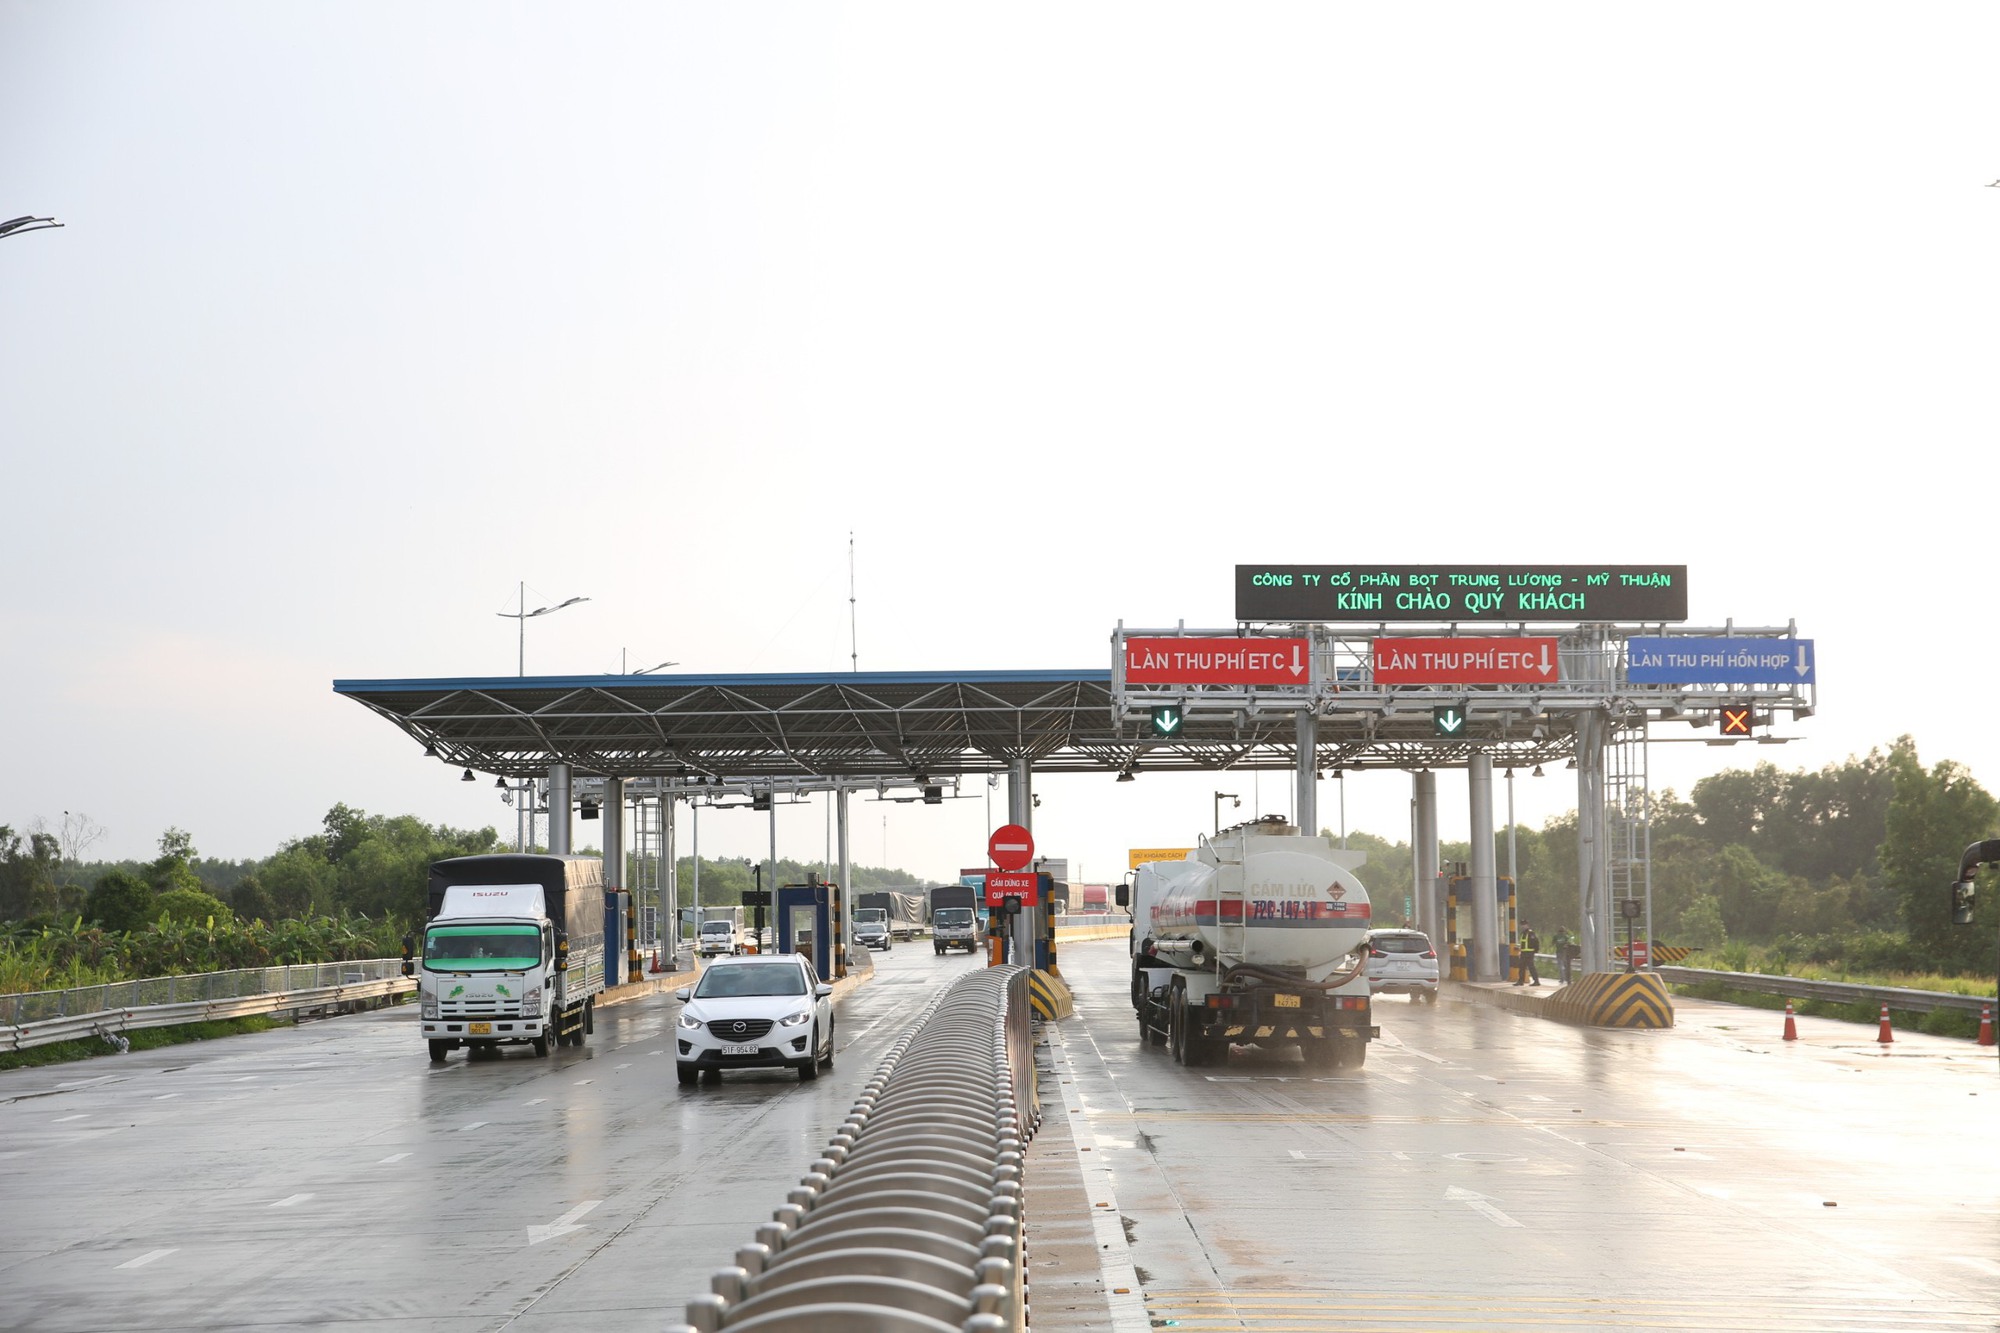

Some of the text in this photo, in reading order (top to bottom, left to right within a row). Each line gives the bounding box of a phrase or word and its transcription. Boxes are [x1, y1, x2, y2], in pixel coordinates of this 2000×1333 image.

[1252, 572, 1293, 586] CÔNG
[1302, 574, 1321, 586] TY
[1409, 574, 1439, 586] BOT
[1450, 574, 1499, 586] TRUNG
[1508, 572, 1562, 586] LƯƠNG
[1587, 572, 1610, 586] MỸ
[1619, 572, 1671, 588] THUẬN
[1337, 586, 1585, 613] KÍNH CHÀO QUÝ KHÁCH
[1130, 648, 1284, 670] LÀN THU PHÍ ETC
[1378, 648, 1534, 670] LÀN THU PHÍ ETC
[1632, 649, 1790, 669] LÀN THU PHÍ HỖN HỢP
[1021, 879, 1029, 887] XE
